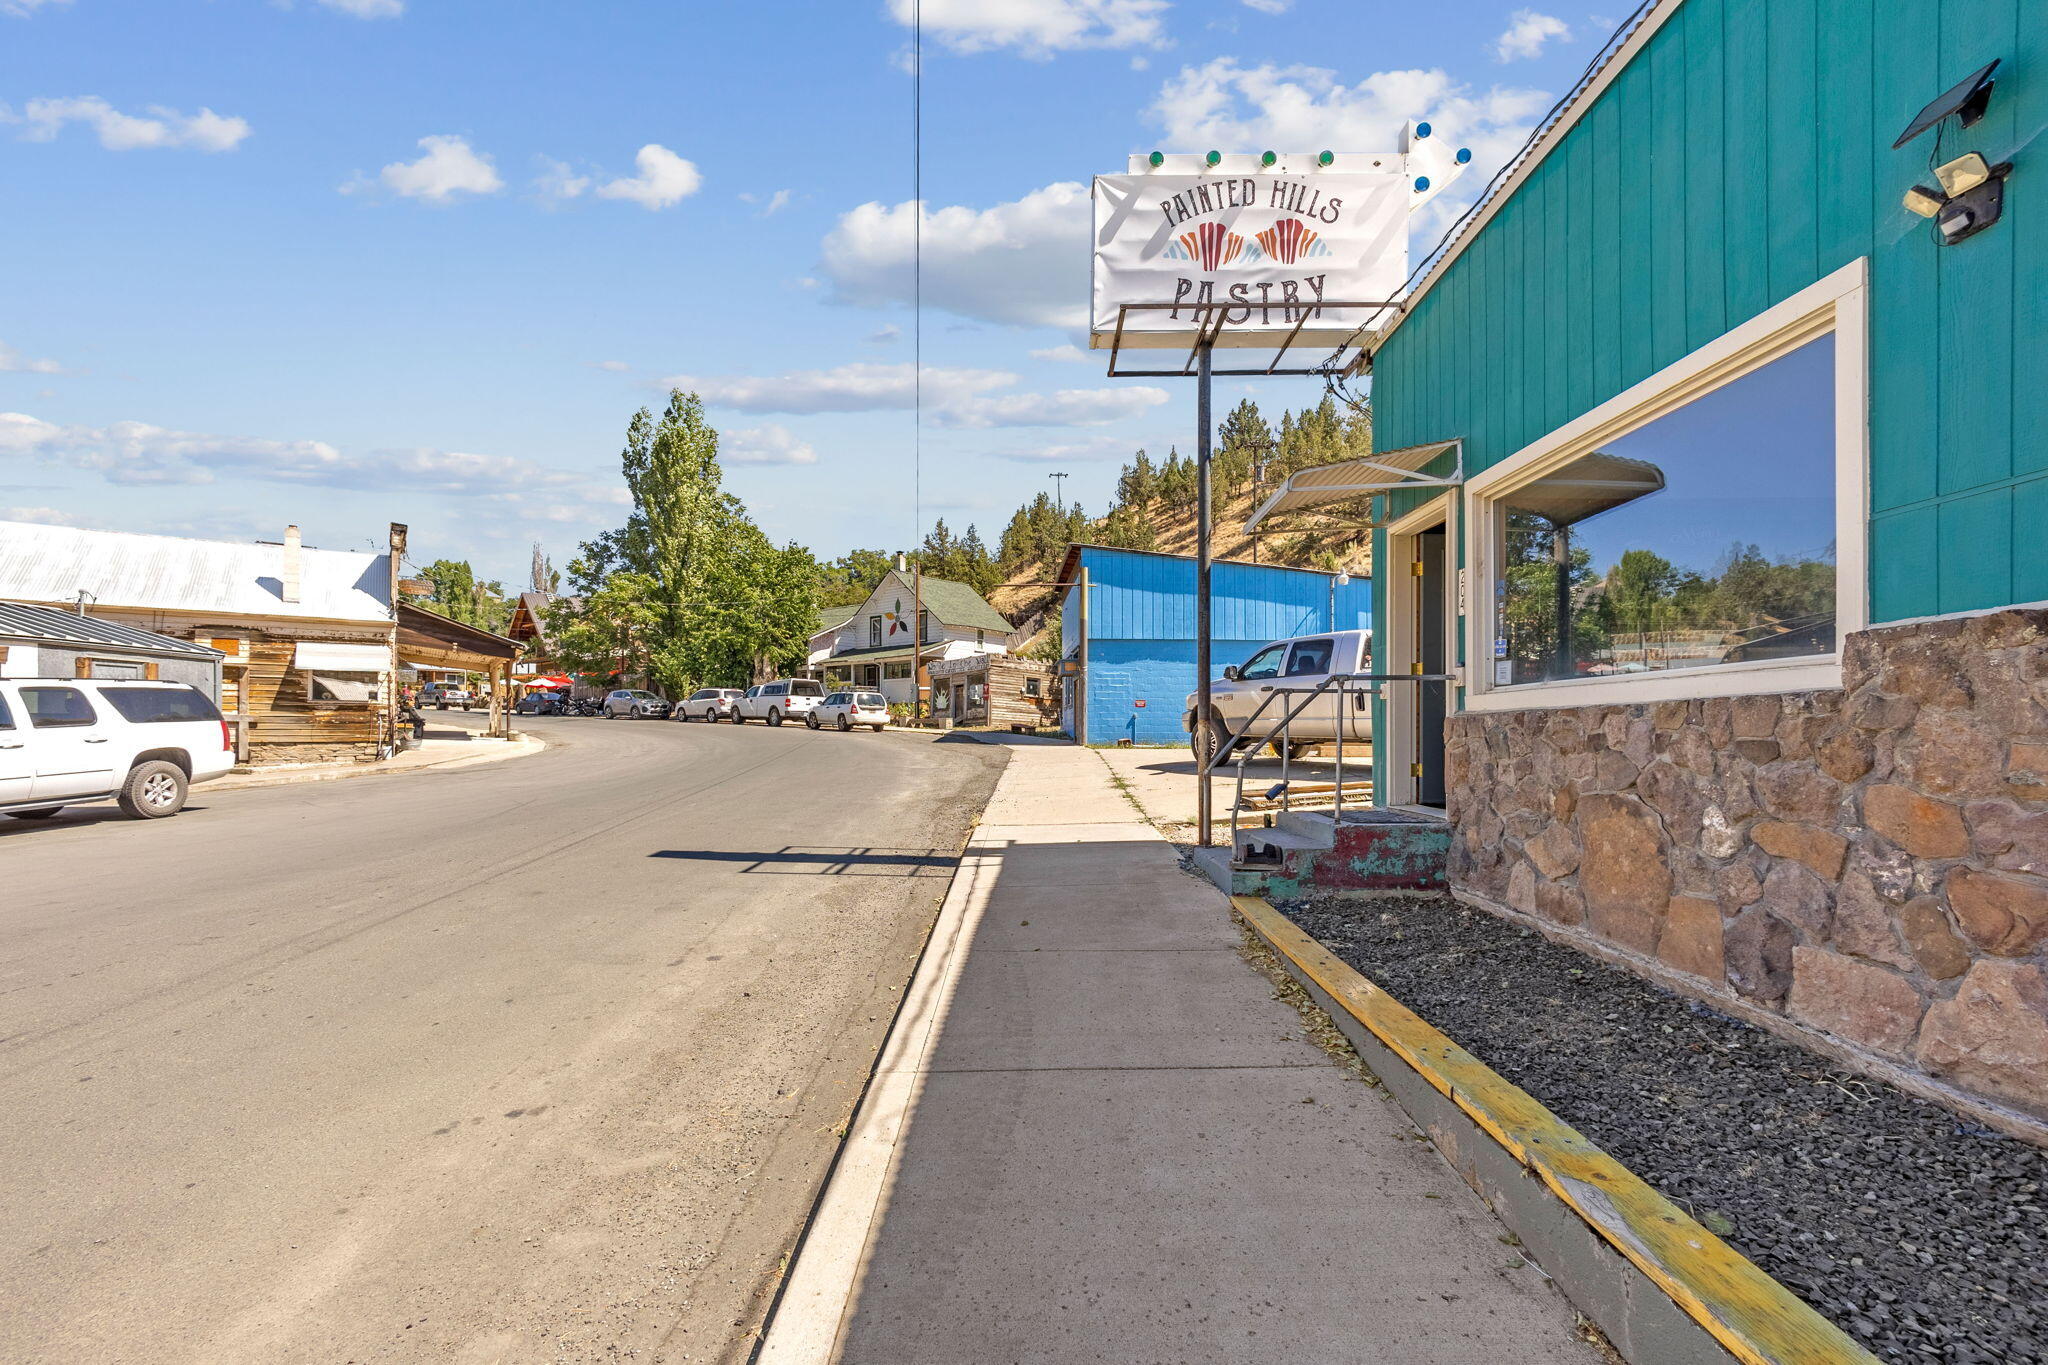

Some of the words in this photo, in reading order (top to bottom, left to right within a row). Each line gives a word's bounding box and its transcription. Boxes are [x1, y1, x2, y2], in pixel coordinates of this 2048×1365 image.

[1160, 178, 1256, 228] PAINTED
[1270, 179, 1343, 224] HILLS
[1169, 274, 1327, 325] PASTRY
